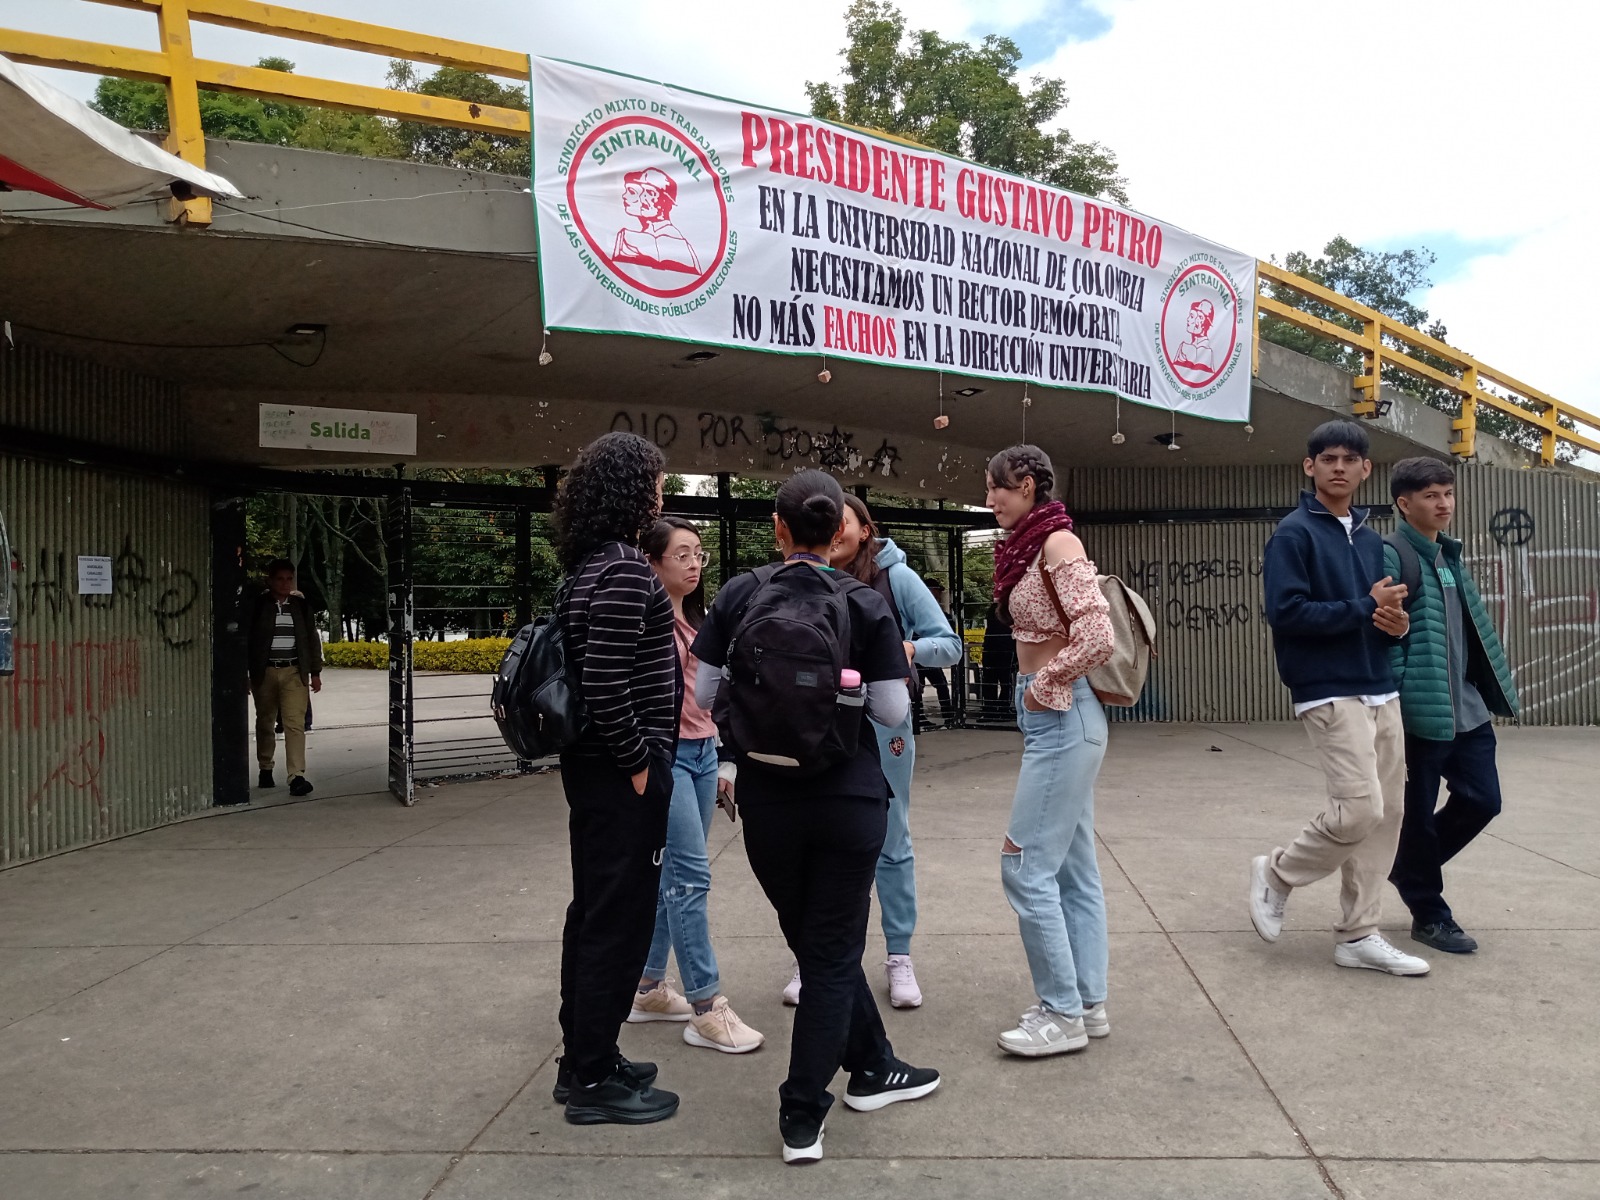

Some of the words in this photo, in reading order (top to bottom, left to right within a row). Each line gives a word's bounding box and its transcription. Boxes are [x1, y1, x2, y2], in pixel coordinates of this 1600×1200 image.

[557, 108, 604, 177] SINDICATO
[604, 98, 648, 116] MIXTO
[650, 101, 668, 117] DE
[670, 108, 735, 204] TRABAJADORES
[591, 129, 704, 183] SINTRAUNAL
[557, 203, 571, 220] DE
[740, 111, 946, 212] PRESIDENTE
[956, 167, 1074, 242] GUSTAVO
[1081, 201, 1163, 269] PETRO
[563, 223, 583, 249] LAS
[758, 184, 786, 234] EN
[791, 191, 820, 239] LA
[826, 198, 956, 267] UNIVERSIDAD
[961, 230, 1041, 286] NACIONAL
[1044, 250, 1068, 292] DE
[1072, 257, 1146, 313] COLOMBIA
[578, 249, 660, 316] UNIVERSIDADES
[705, 230, 738, 299] NACIONALES
[790, 247, 925, 313] NECESITAMOS
[931, 273, 953, 317] UN
[958, 279, 1027, 328] RECTOR
[1159, 258, 1188, 304] SINDICATO
[1188, 252, 1209, 263] MIXTO
[1209, 255, 1218, 266] DE
[661, 293, 708, 317] PÚBLICAS
[1177, 272, 1233, 311] SINTRAUNAL
[732, 293, 762, 342] NO
[769, 294, 816, 347] MÁS
[823, 305, 897, 359] FACHOS
[903, 319, 928, 362] EN
[934, 323, 955, 366] LA
[959, 332, 1044, 379] DIRECCIÓN
[1049, 343, 1152, 400] UNIVERSTARIA
[1154, 322, 1161, 334] DE
[1154, 335, 1163, 355] LAS
[1215, 341, 1243, 390] NACIONALES
[1191, 386, 1218, 402] PÚBLICAS
[310, 421, 371, 440] Salida
[697, 412, 752, 447] POR
